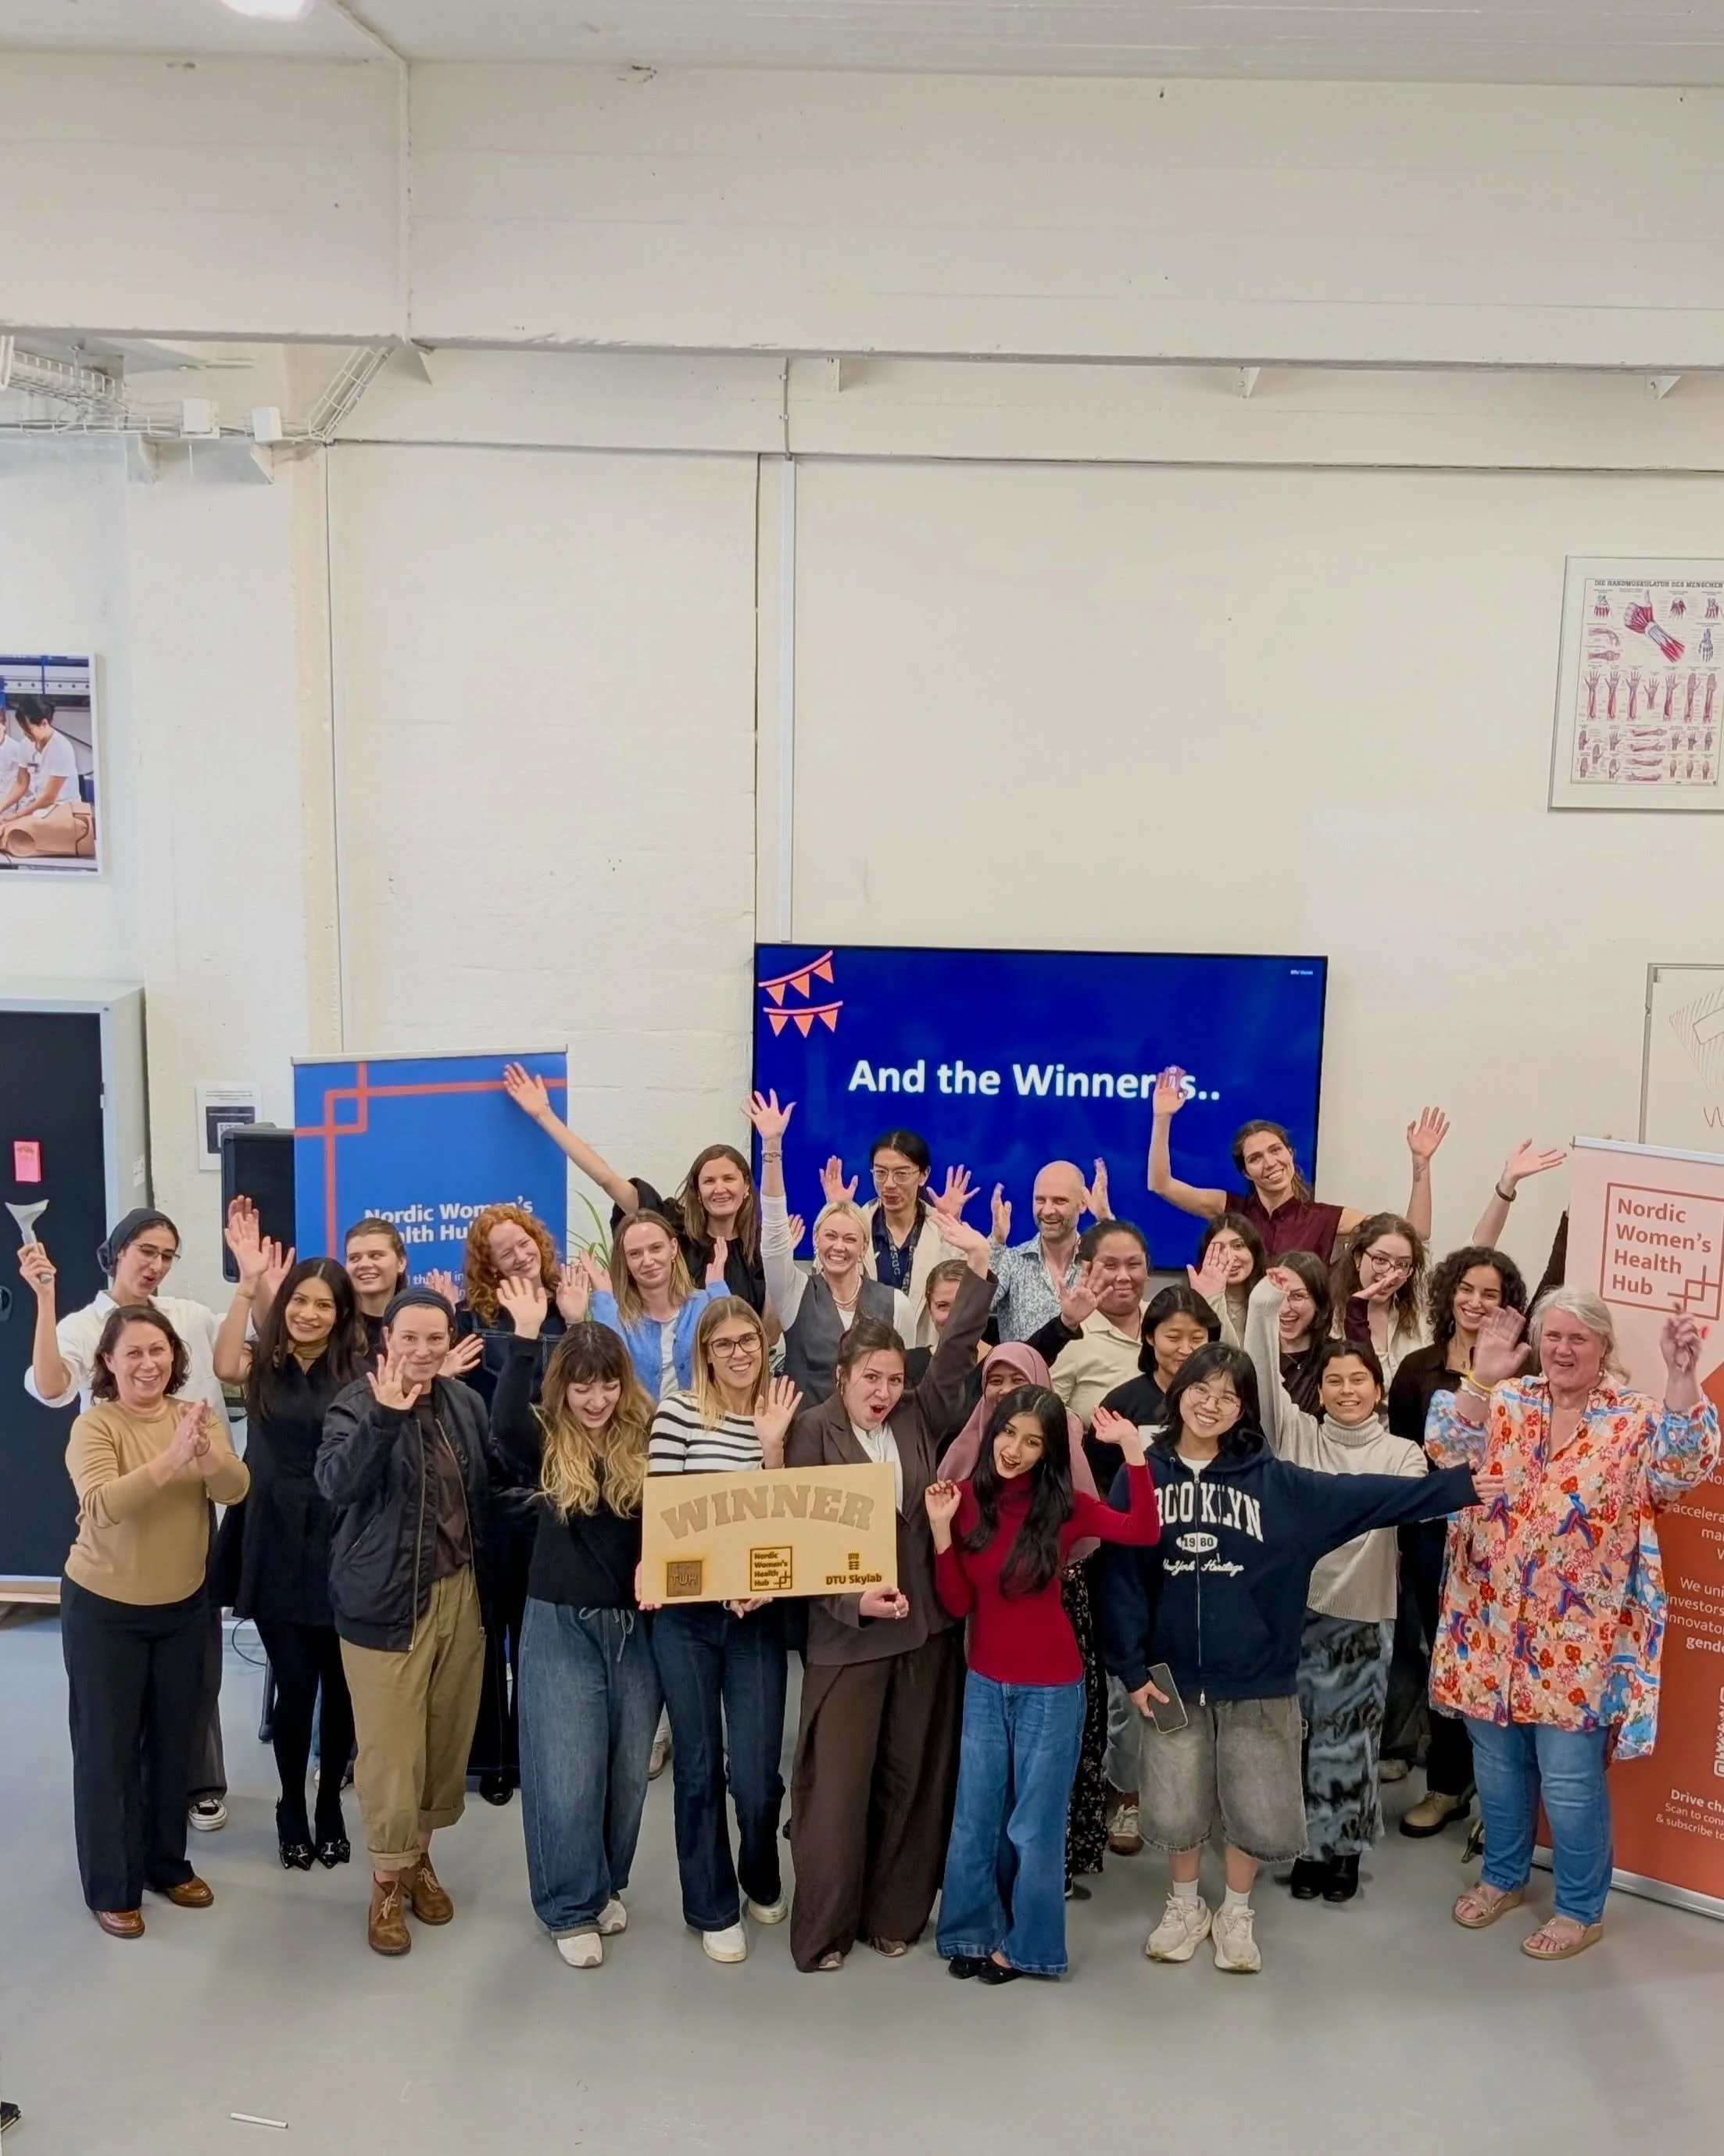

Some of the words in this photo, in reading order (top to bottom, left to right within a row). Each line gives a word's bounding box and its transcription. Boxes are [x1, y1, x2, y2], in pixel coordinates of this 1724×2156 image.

[848, 1060, 925, 1093] And
[937, 1060, 1001, 1096] the
[1013, 1064, 1157, 1099] Winner
[365, 1203, 435, 1224] Nordic
[1618, 1198, 1686, 1224] Nordic
[440, 1221, 474, 1241] Hu
[1615, 1223, 1711, 1253] Women's
[1614, 1249, 1682, 1275] Health
[1612, 1274, 1653, 1296] Hub
[660, 1484, 875, 1540] WINNER
[1154, 1481, 1264, 1543] ROOKLYN
[754, 1551, 779, 1560] Nordic
[754, 1560, 788, 1568] Women's
[754, 1579, 770, 1587] Hub
[826, 1575, 846, 1586] DTU
[849, 1573, 882, 1586] Skylab
[1679, 1577, 1701, 1592] We
[1671, 1788, 1704, 1807] Drive
[1665, 1802, 1688, 1817] Scan
[1690, 1810, 1702, 1820] to
[1655, 1813, 1664, 1824] &
[1665, 1818, 1713, 1837] subscribe
